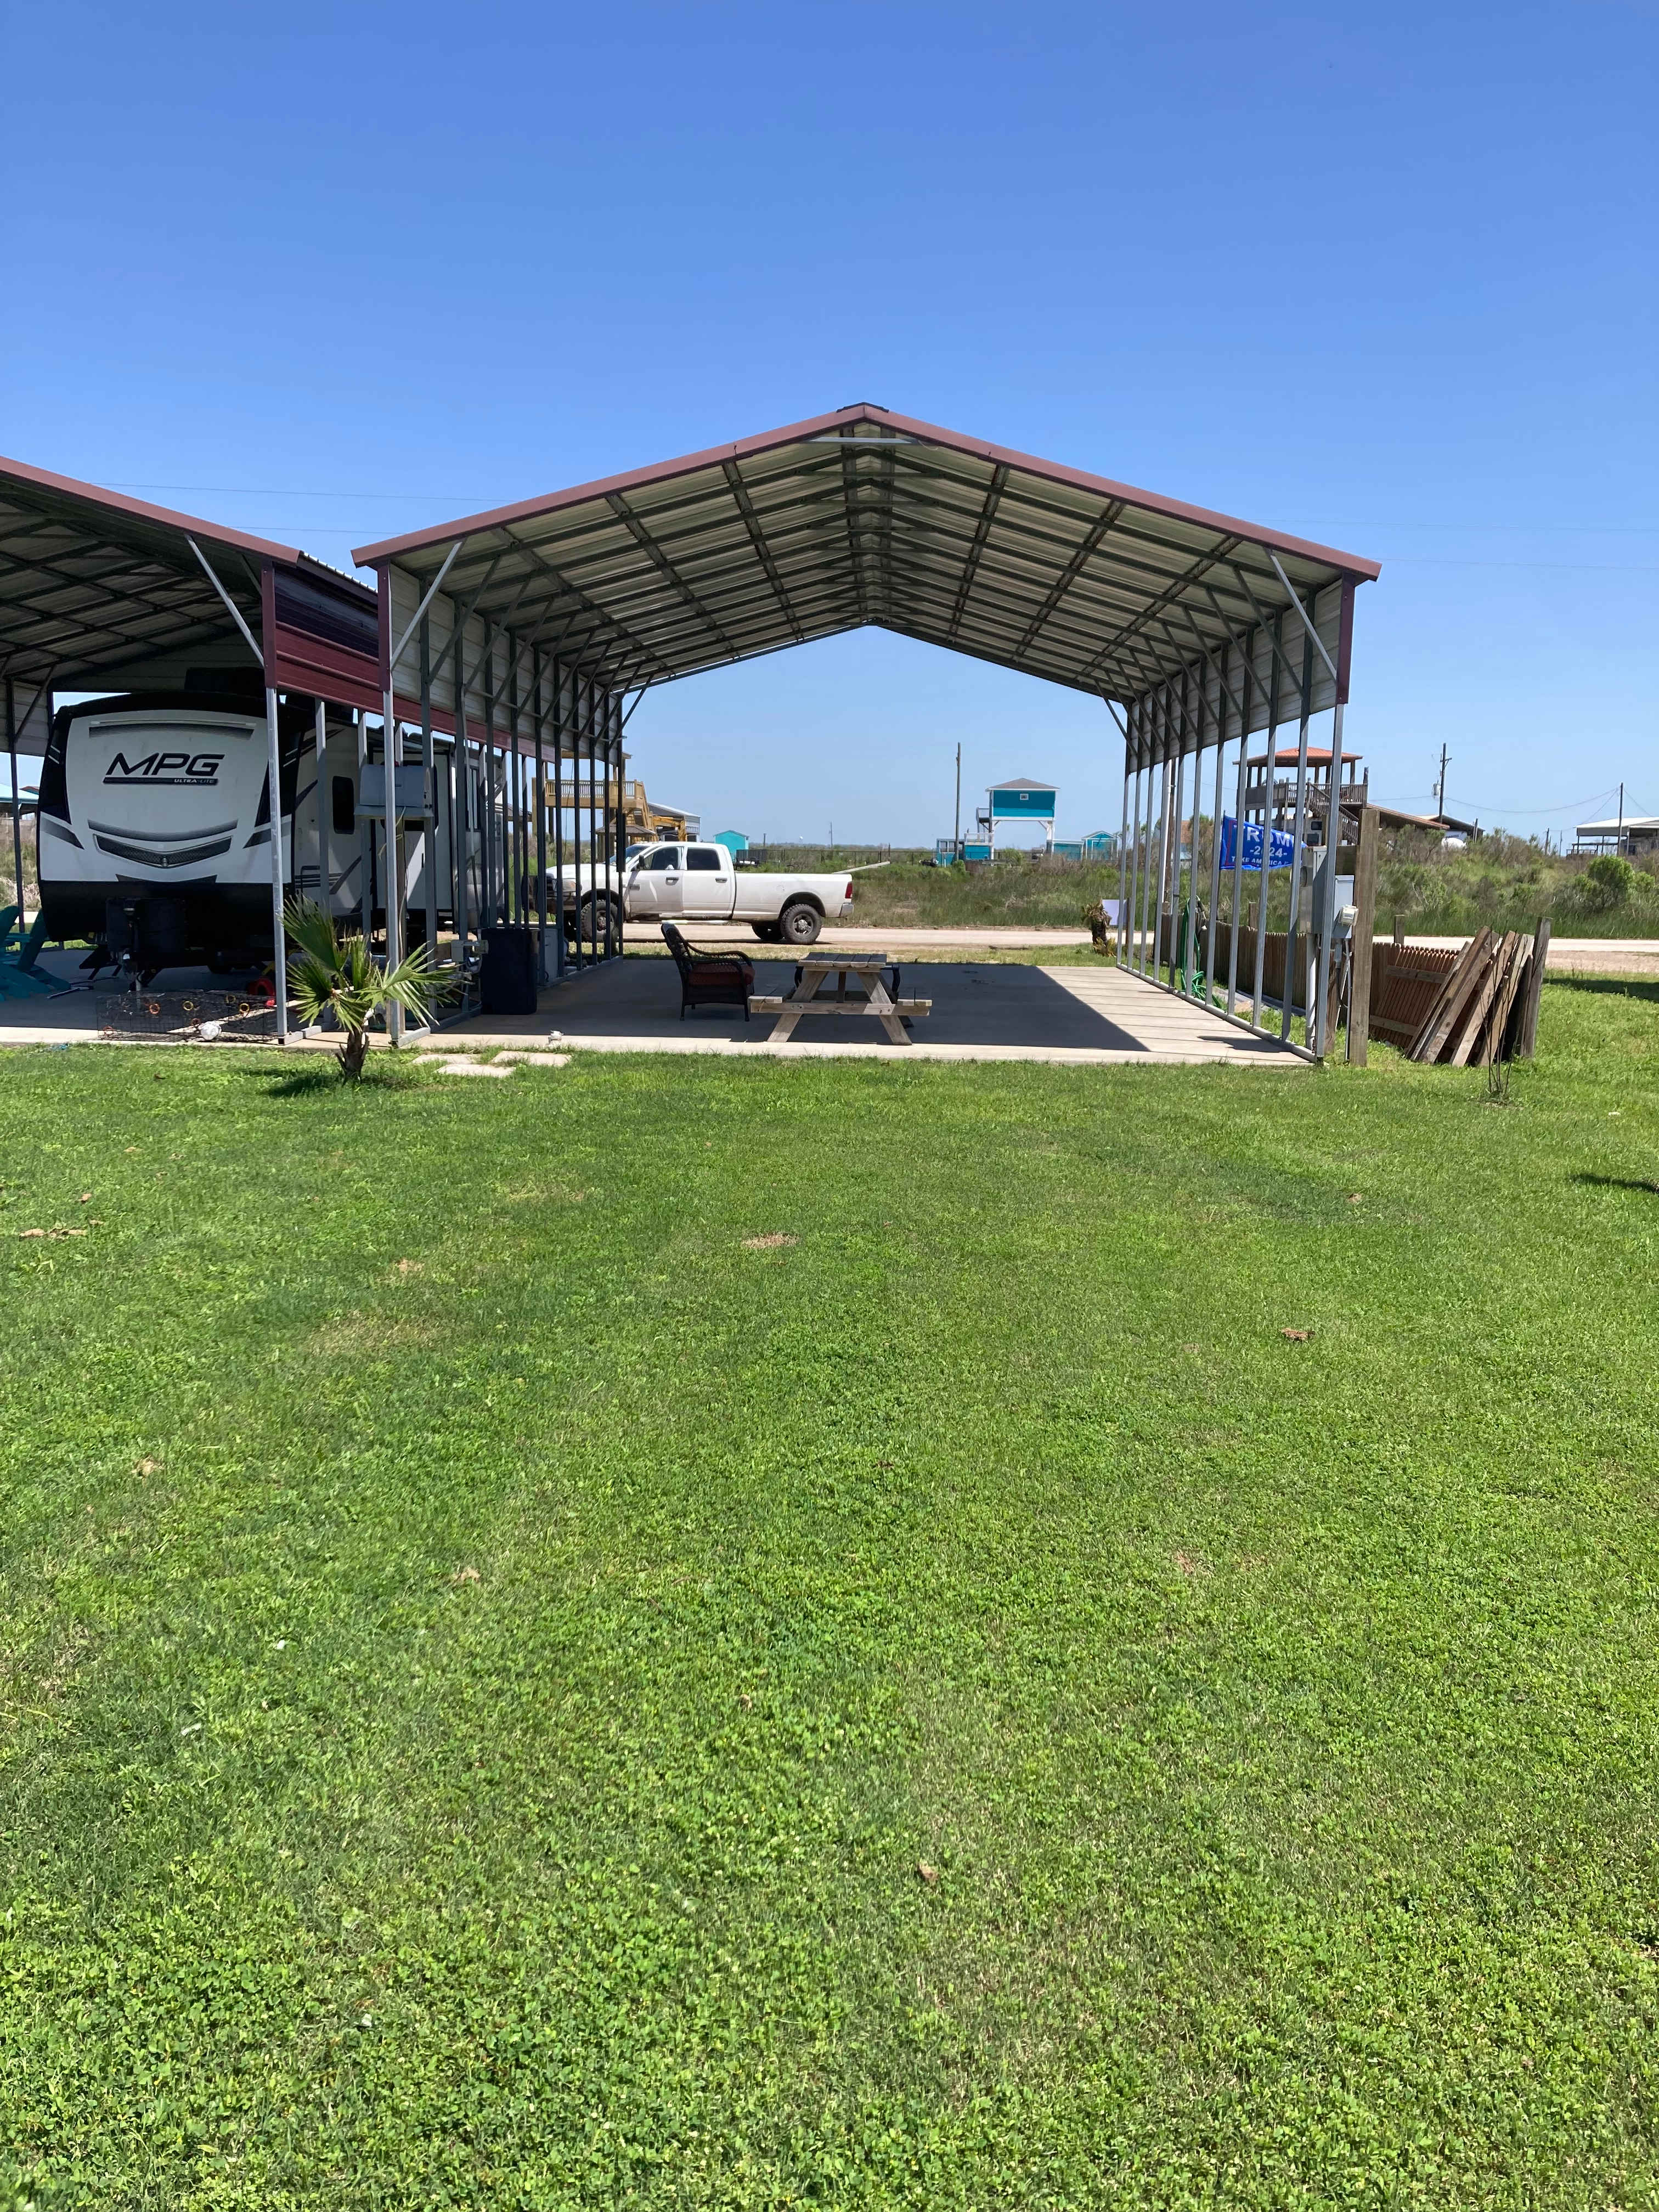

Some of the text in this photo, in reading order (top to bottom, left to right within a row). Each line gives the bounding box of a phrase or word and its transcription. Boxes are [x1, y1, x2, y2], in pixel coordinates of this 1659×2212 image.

[105, 752, 225, 776] MPG
[1233, 825, 1295, 848] RUM
[1250, 845, 1288, 857] -224-
